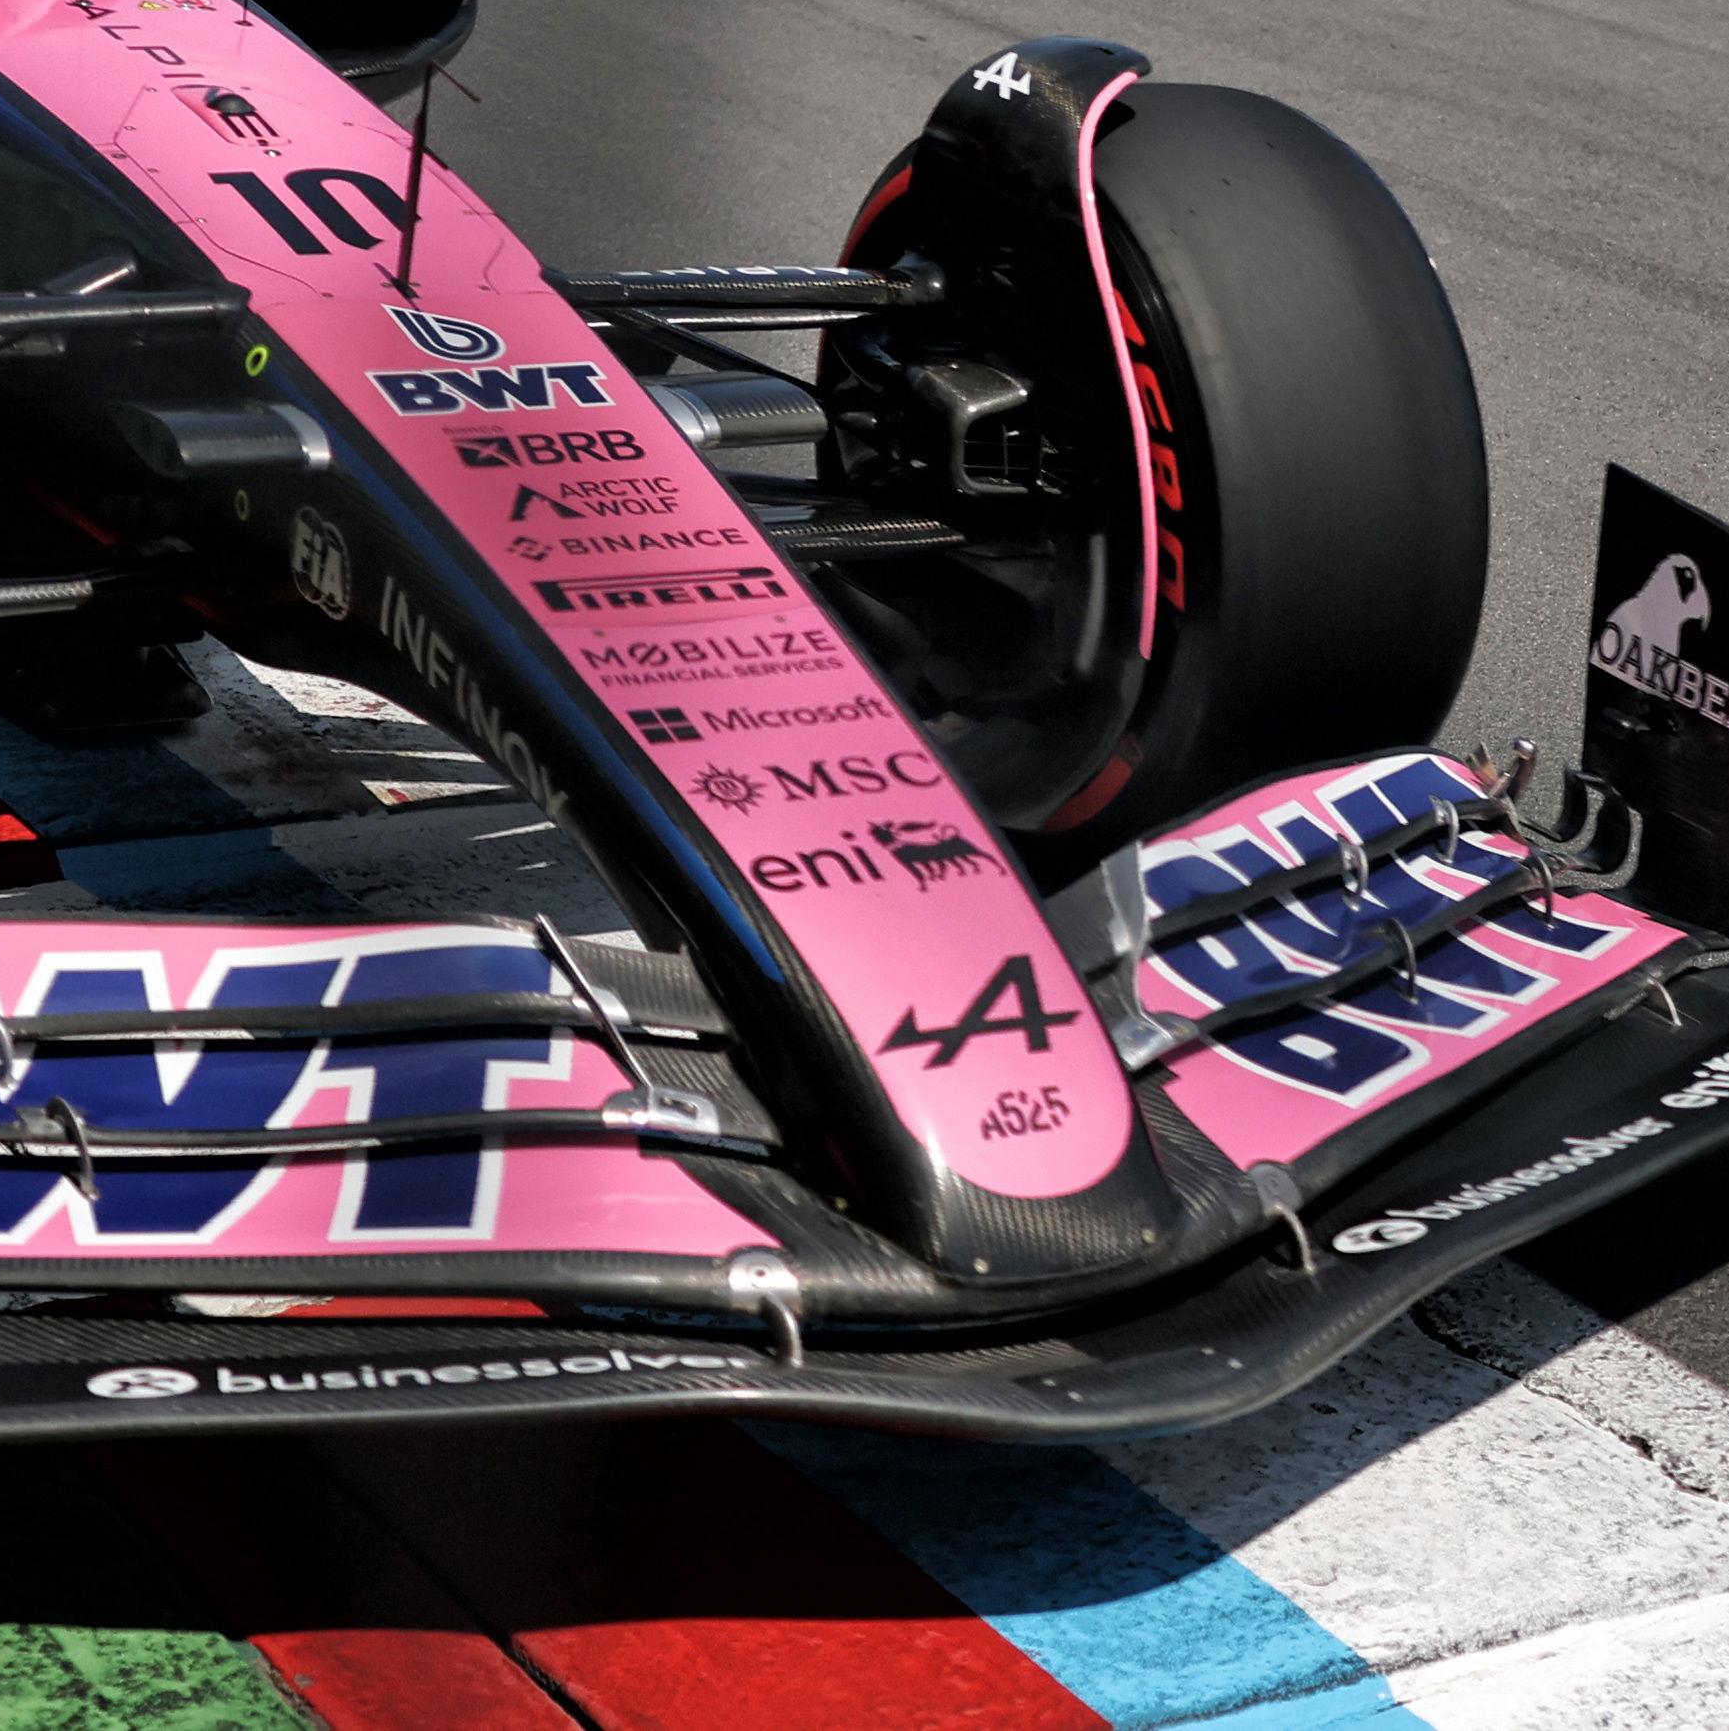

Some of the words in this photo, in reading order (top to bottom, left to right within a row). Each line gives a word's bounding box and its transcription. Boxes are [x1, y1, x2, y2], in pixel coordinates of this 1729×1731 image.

[208, 167, 423, 256] 10
[364, 361, 616, 417] BWT
[518, 429, 647, 466] BRB
[558, 476, 681, 500] ARCTIC
[582, 496, 680, 518] WOLF
[561, 527, 750, 556] BINANCE
[532, 566, 789, 613] PIRELLI
[599, 663, 729, 688] FINANCIAL
[732, 656, 845, 678] SERVICES
[702, 695, 894, 735] Microsoft
[762, 751, 943, 803] MSC
[750, 830, 884, 894] eni
[1385, 1115, 1676, 1221] businessolver
[217, 1349, 748, 1394] businessolver
